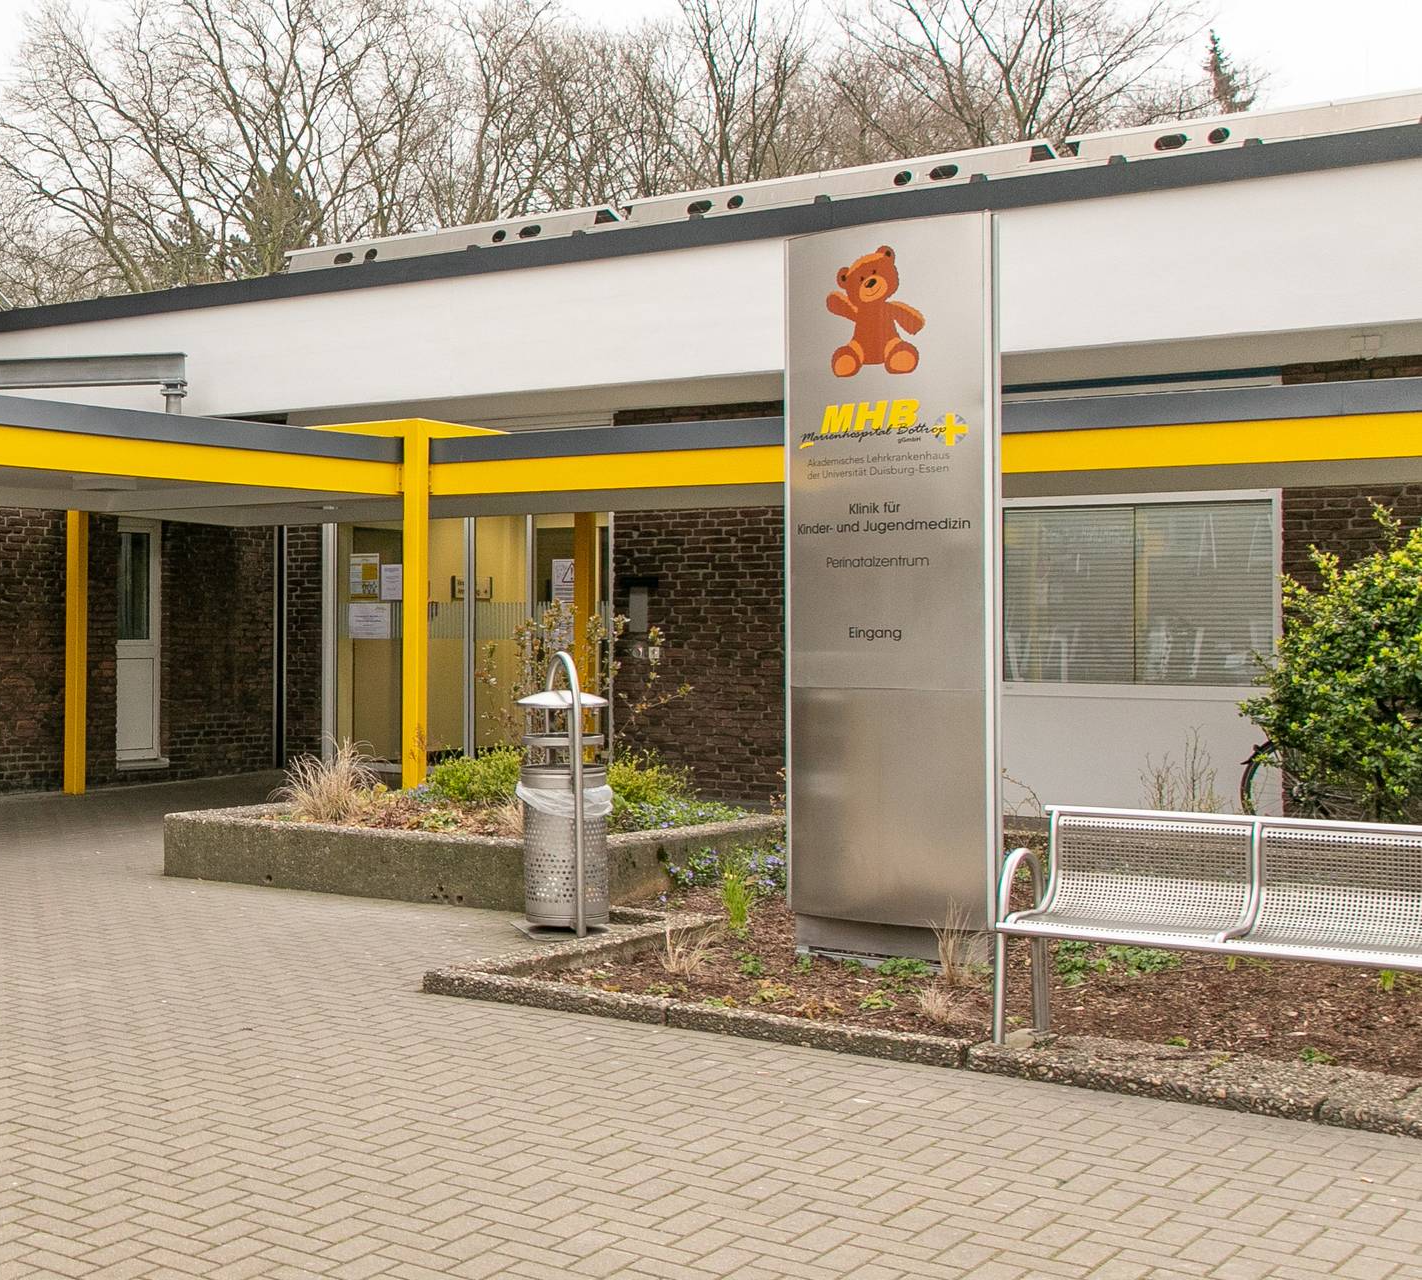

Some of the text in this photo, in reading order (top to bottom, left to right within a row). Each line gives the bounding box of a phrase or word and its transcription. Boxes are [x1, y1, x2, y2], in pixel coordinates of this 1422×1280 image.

[821, 399, 920, 434] MHB
[800, 423, 947, 443] Marienhospital Bottrop
[807, 451, 951, 467] Akademisches Lehrkrankenhaus
[807, 463, 949, 480] der Universität Duisburg-Essen
[849, 501, 901, 515] Klinik für
[797, 517, 971, 535] Kinder- und Jugendmedizin
[826, 555, 930, 569] Perinatalzentrum
[849, 627, 902, 642] Eingang
